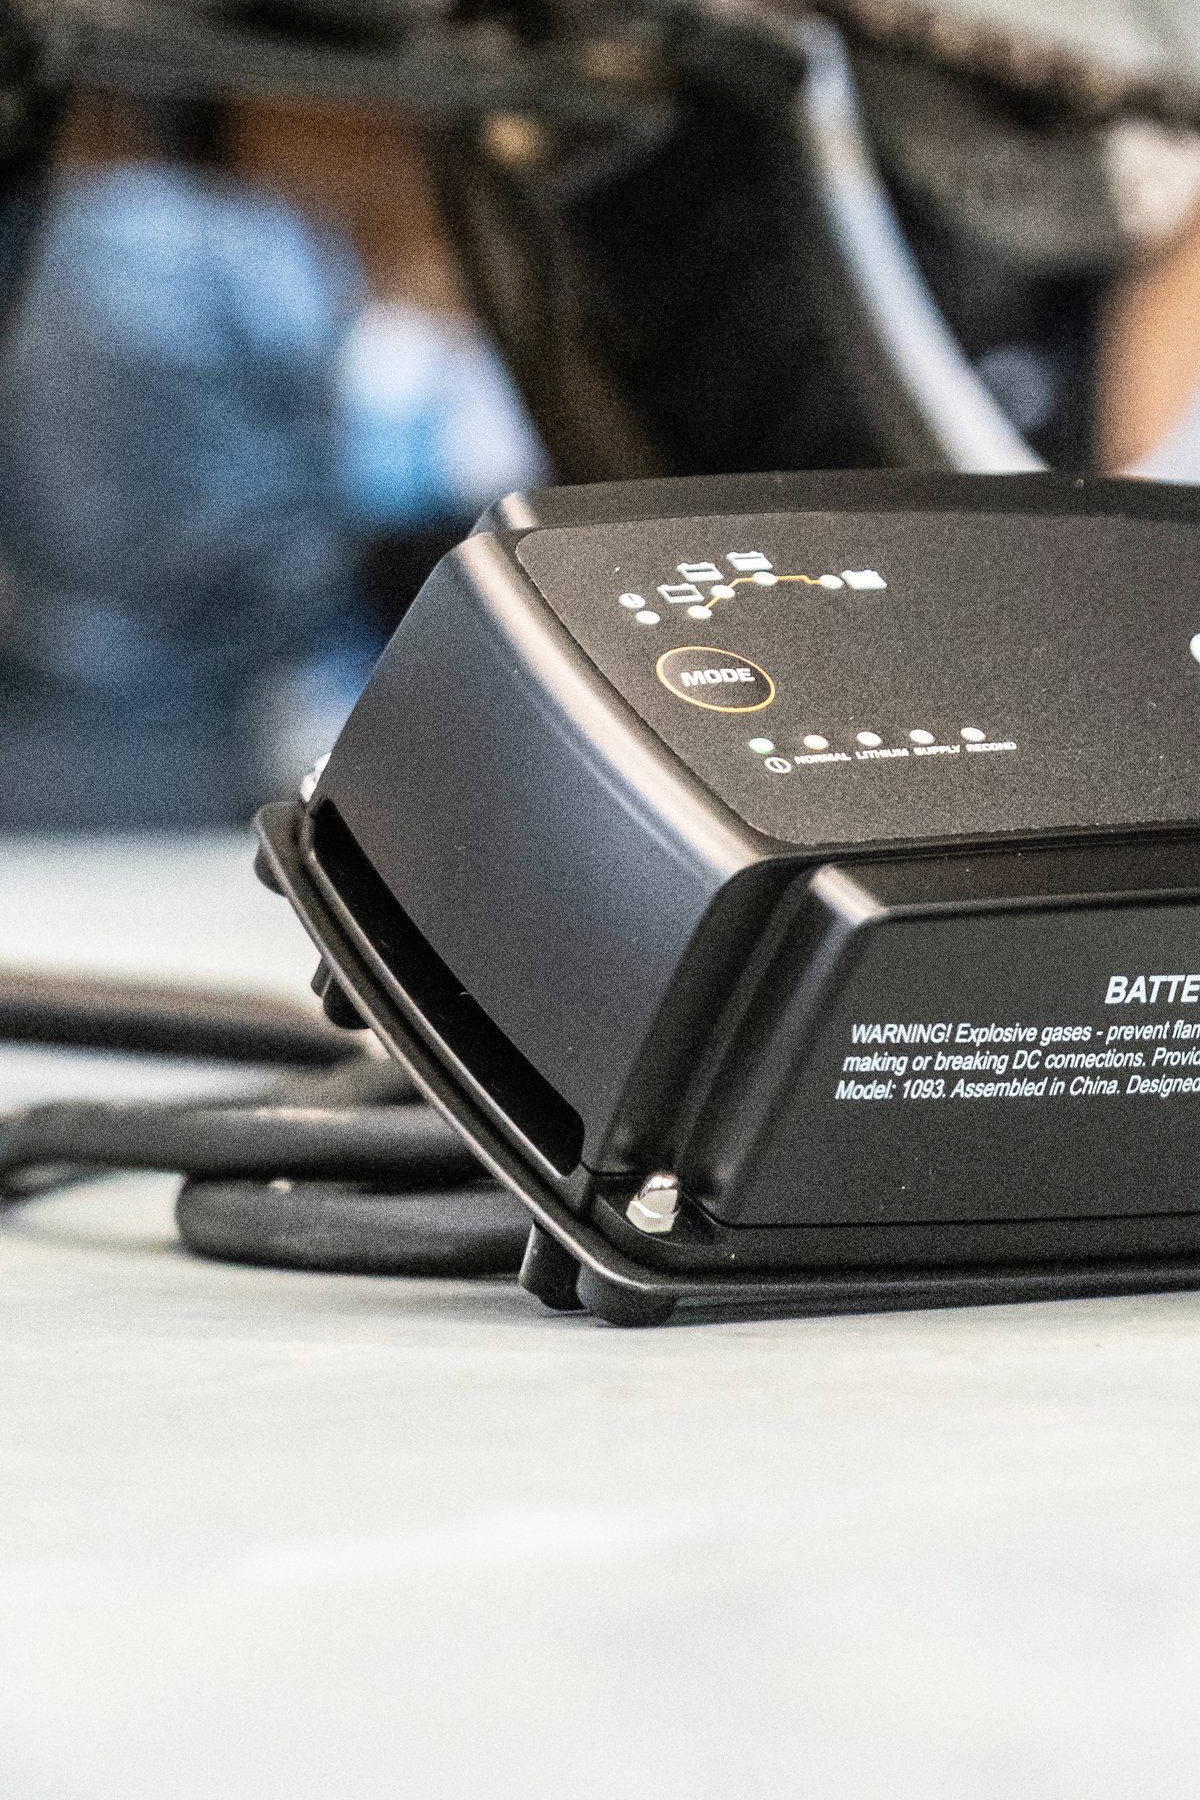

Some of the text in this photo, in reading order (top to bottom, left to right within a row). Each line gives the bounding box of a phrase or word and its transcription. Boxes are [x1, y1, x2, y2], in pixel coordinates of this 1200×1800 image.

[681, 667, 755, 686] MODE
[794, 751, 851, 765] NORMAL
[856, 747, 909, 760] LITHIUM
[913, 743, 960, 756] SUPPLY
[851, 1023, 952, 1044] WARNING!
[955, 1023, 1037, 1047] Explosive
[1040, 1025, 1092, 1046] gases
[1105, 1021, 1170, 1044] prevent
[843, 1052, 908, 1076] making
[912, 1055, 932, 1071] or
[934, 1051, 1009, 1074] breaking
[1012, 1049, 1042, 1069] DC
[1045, 1049, 1145, 1069] connections.
[835, 1080, 896, 1100] Model:
[902, 1079, 945, 1098] 1093.
[950, 1077, 1047, 1098] Assembled
[1049, 1077, 1065, 1096] in
[1069, 1076, 1120, 1096] China.
